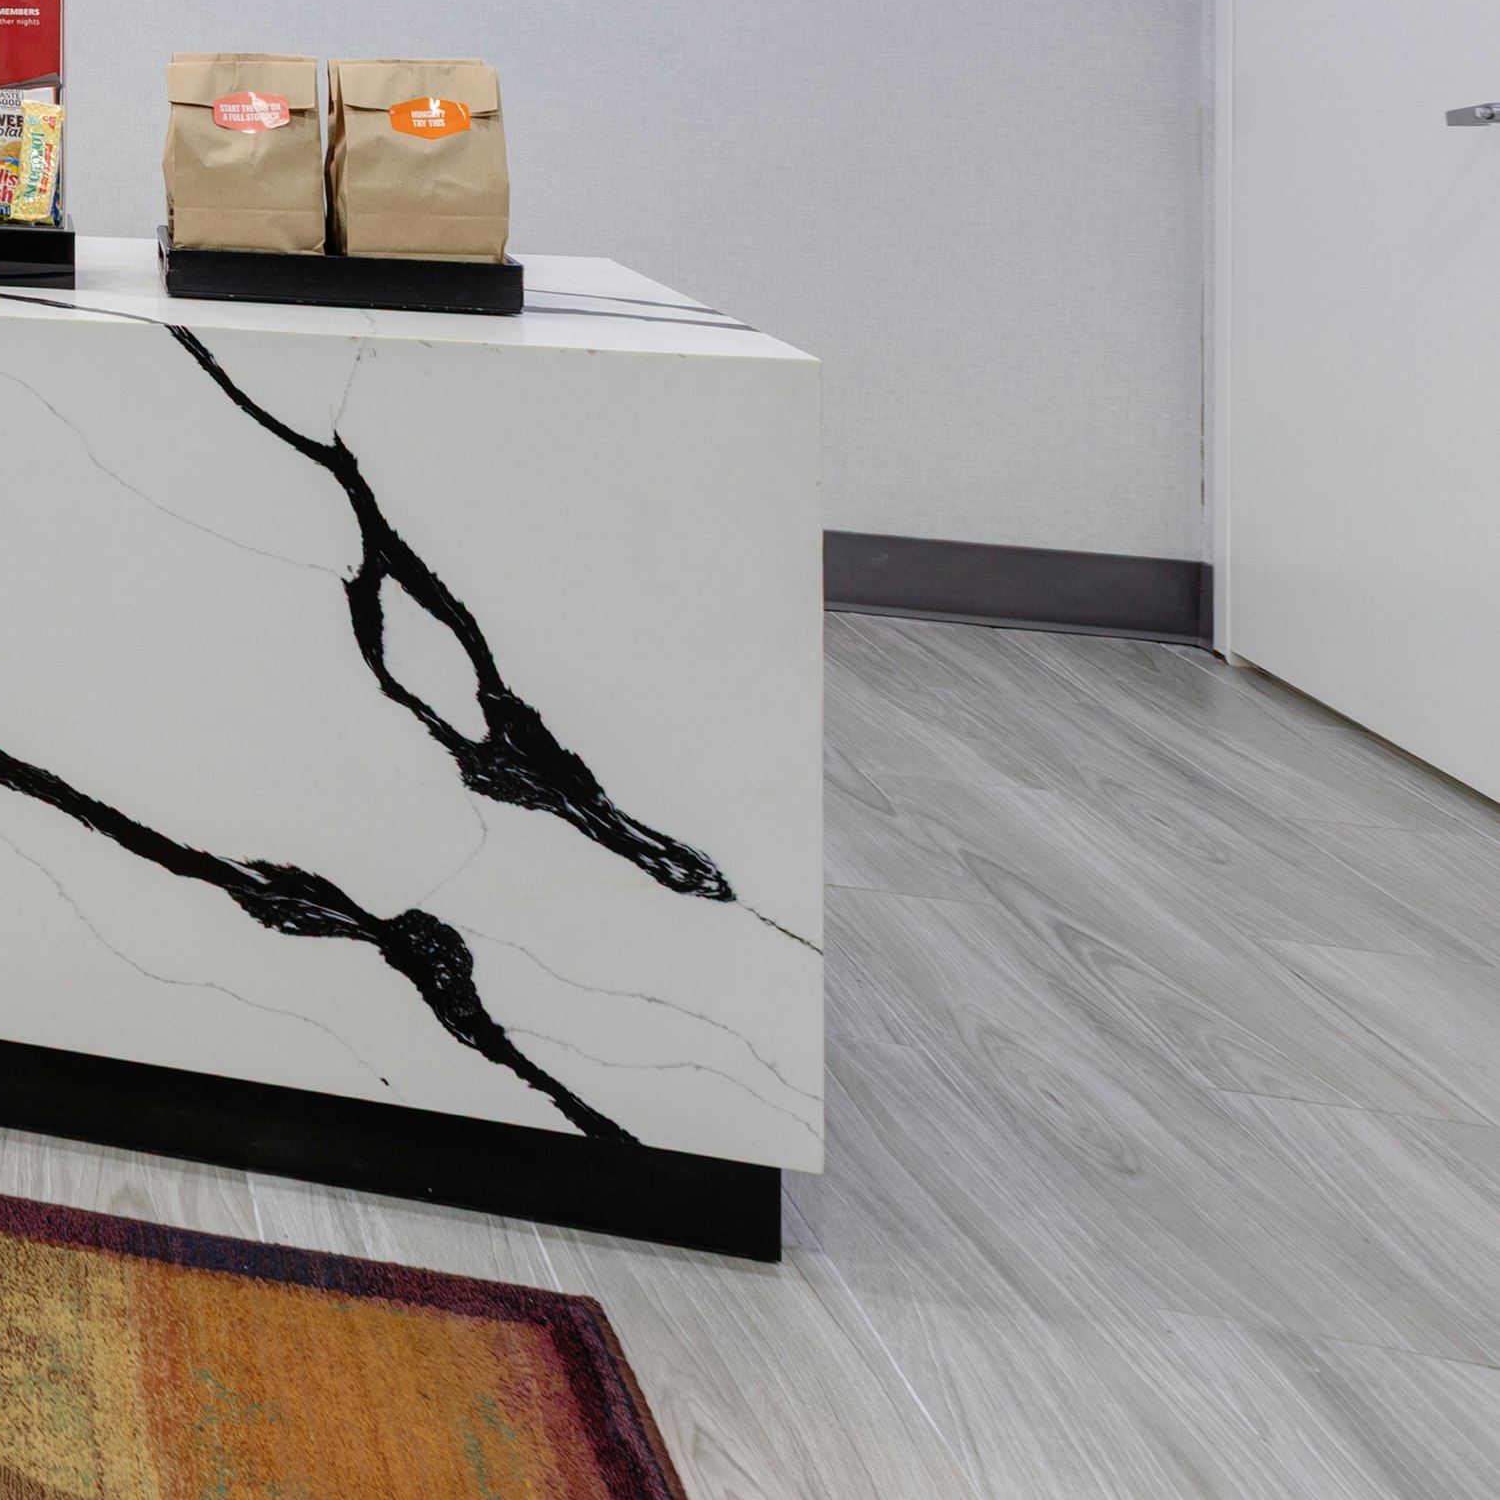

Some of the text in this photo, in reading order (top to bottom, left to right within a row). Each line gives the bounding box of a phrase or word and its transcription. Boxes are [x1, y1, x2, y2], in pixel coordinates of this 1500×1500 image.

[17, 18, 40, 26] nights
[220, 104, 240, 112] START
[229, 114, 245, 122] FULL
[412, 119, 445, 127] TRY THIS
